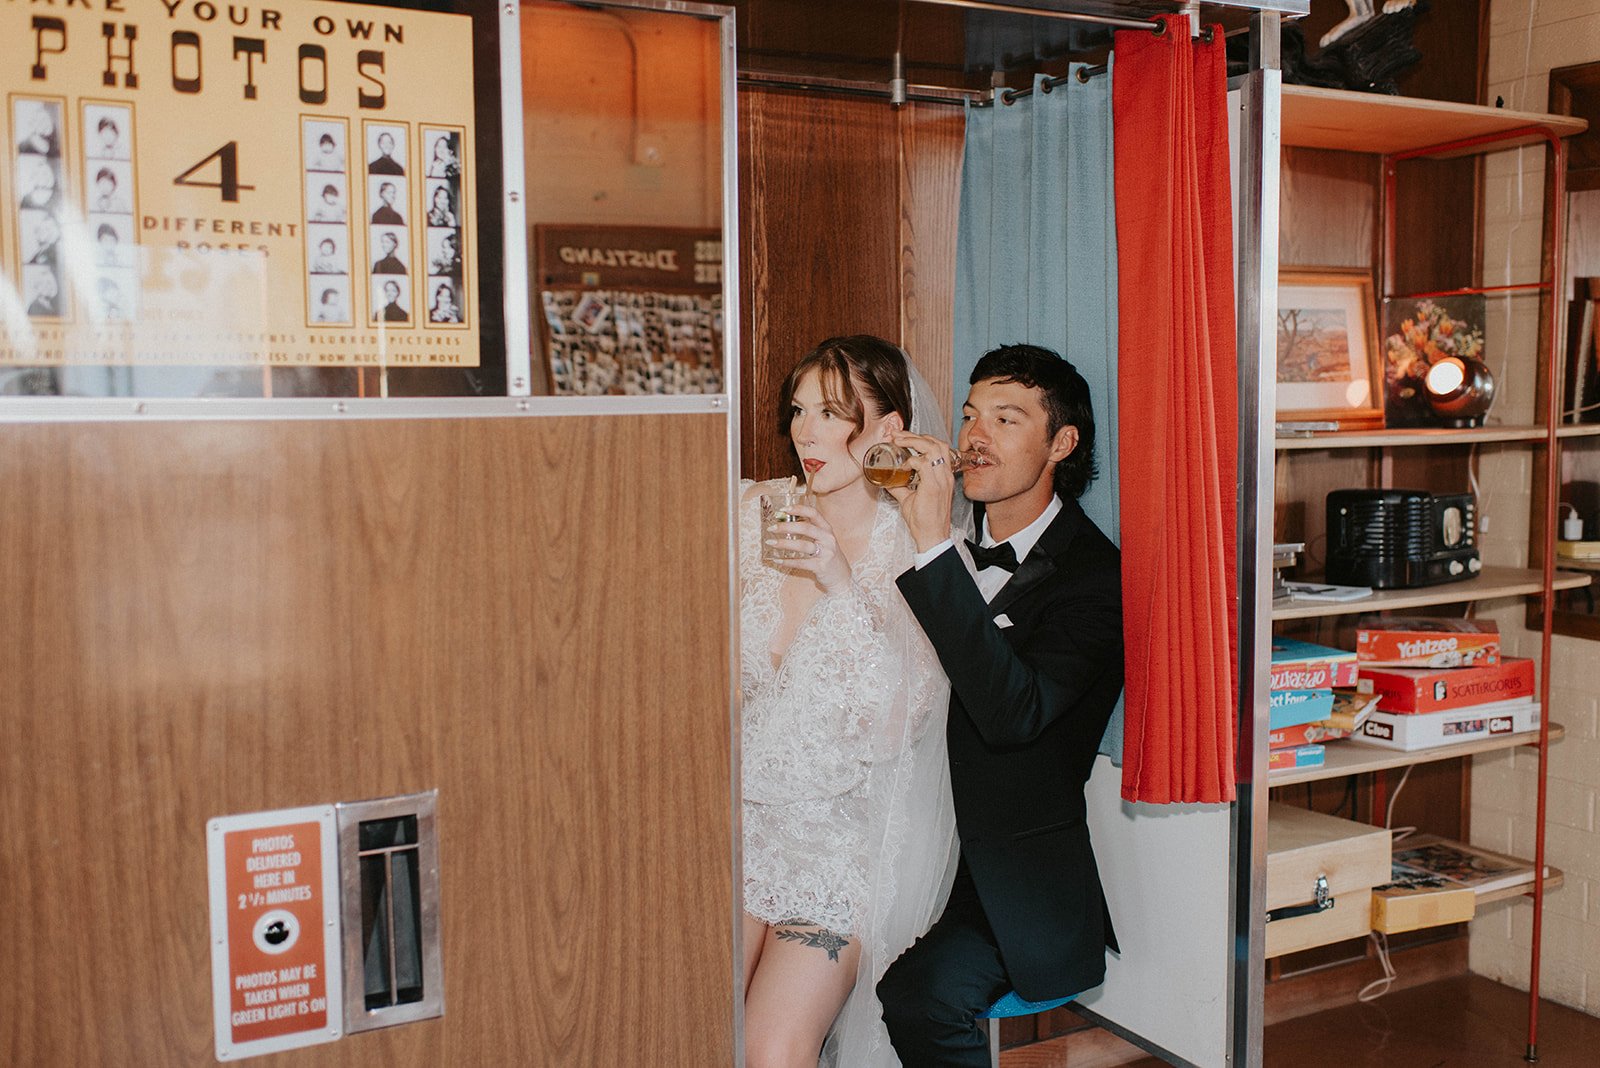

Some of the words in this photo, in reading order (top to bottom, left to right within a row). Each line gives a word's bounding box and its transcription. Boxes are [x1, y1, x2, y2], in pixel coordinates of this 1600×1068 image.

[162, 0, 282, 31] YOUR
[313, 15, 404, 44] OWN
[31, 14, 387, 110] PHOTOS
[173, 140, 256, 203] 4
[143, 215, 298, 237] DIFFERENT
[310, 334, 377, 345] BLURRED
[389, 336, 461, 346] PICTURES
[319, 354, 346, 362] HOW
[354, 354, 384, 362] MUC
[395, 354, 422, 362] THEY
[429, 354, 461, 363] MOVE
[1396, 637, 1459, 659] Yahtzee
[1452, 677, 1522, 698] SCATTERGORIES
[1285, 692, 1309, 706] Four
[1366, 722, 1391, 738] Clue
[1489, 718, 1512, 733] Clue
[252, 834, 295, 853] PHOTOS
[246, 851, 302, 873] DELIVERED
[253, 871, 282, 889] HERE
[283, 870, 296, 885] IN
[238, 893, 247, 910] 2
[266, 884, 312, 905] MINUTES
[235, 969, 278, 991] PHOTOS
[279, 966, 302, 983] MAY
[302, 963, 317, 980] BE
[244, 988, 277, 1007] TAKEN
[278, 982, 310, 1000] WHEN
[232, 1007, 266, 1027] GREEN
[267, 1001, 297, 1020] LIGHT
[298, 1000, 309, 1015] IS
[309, 997, 326, 1013] ON
